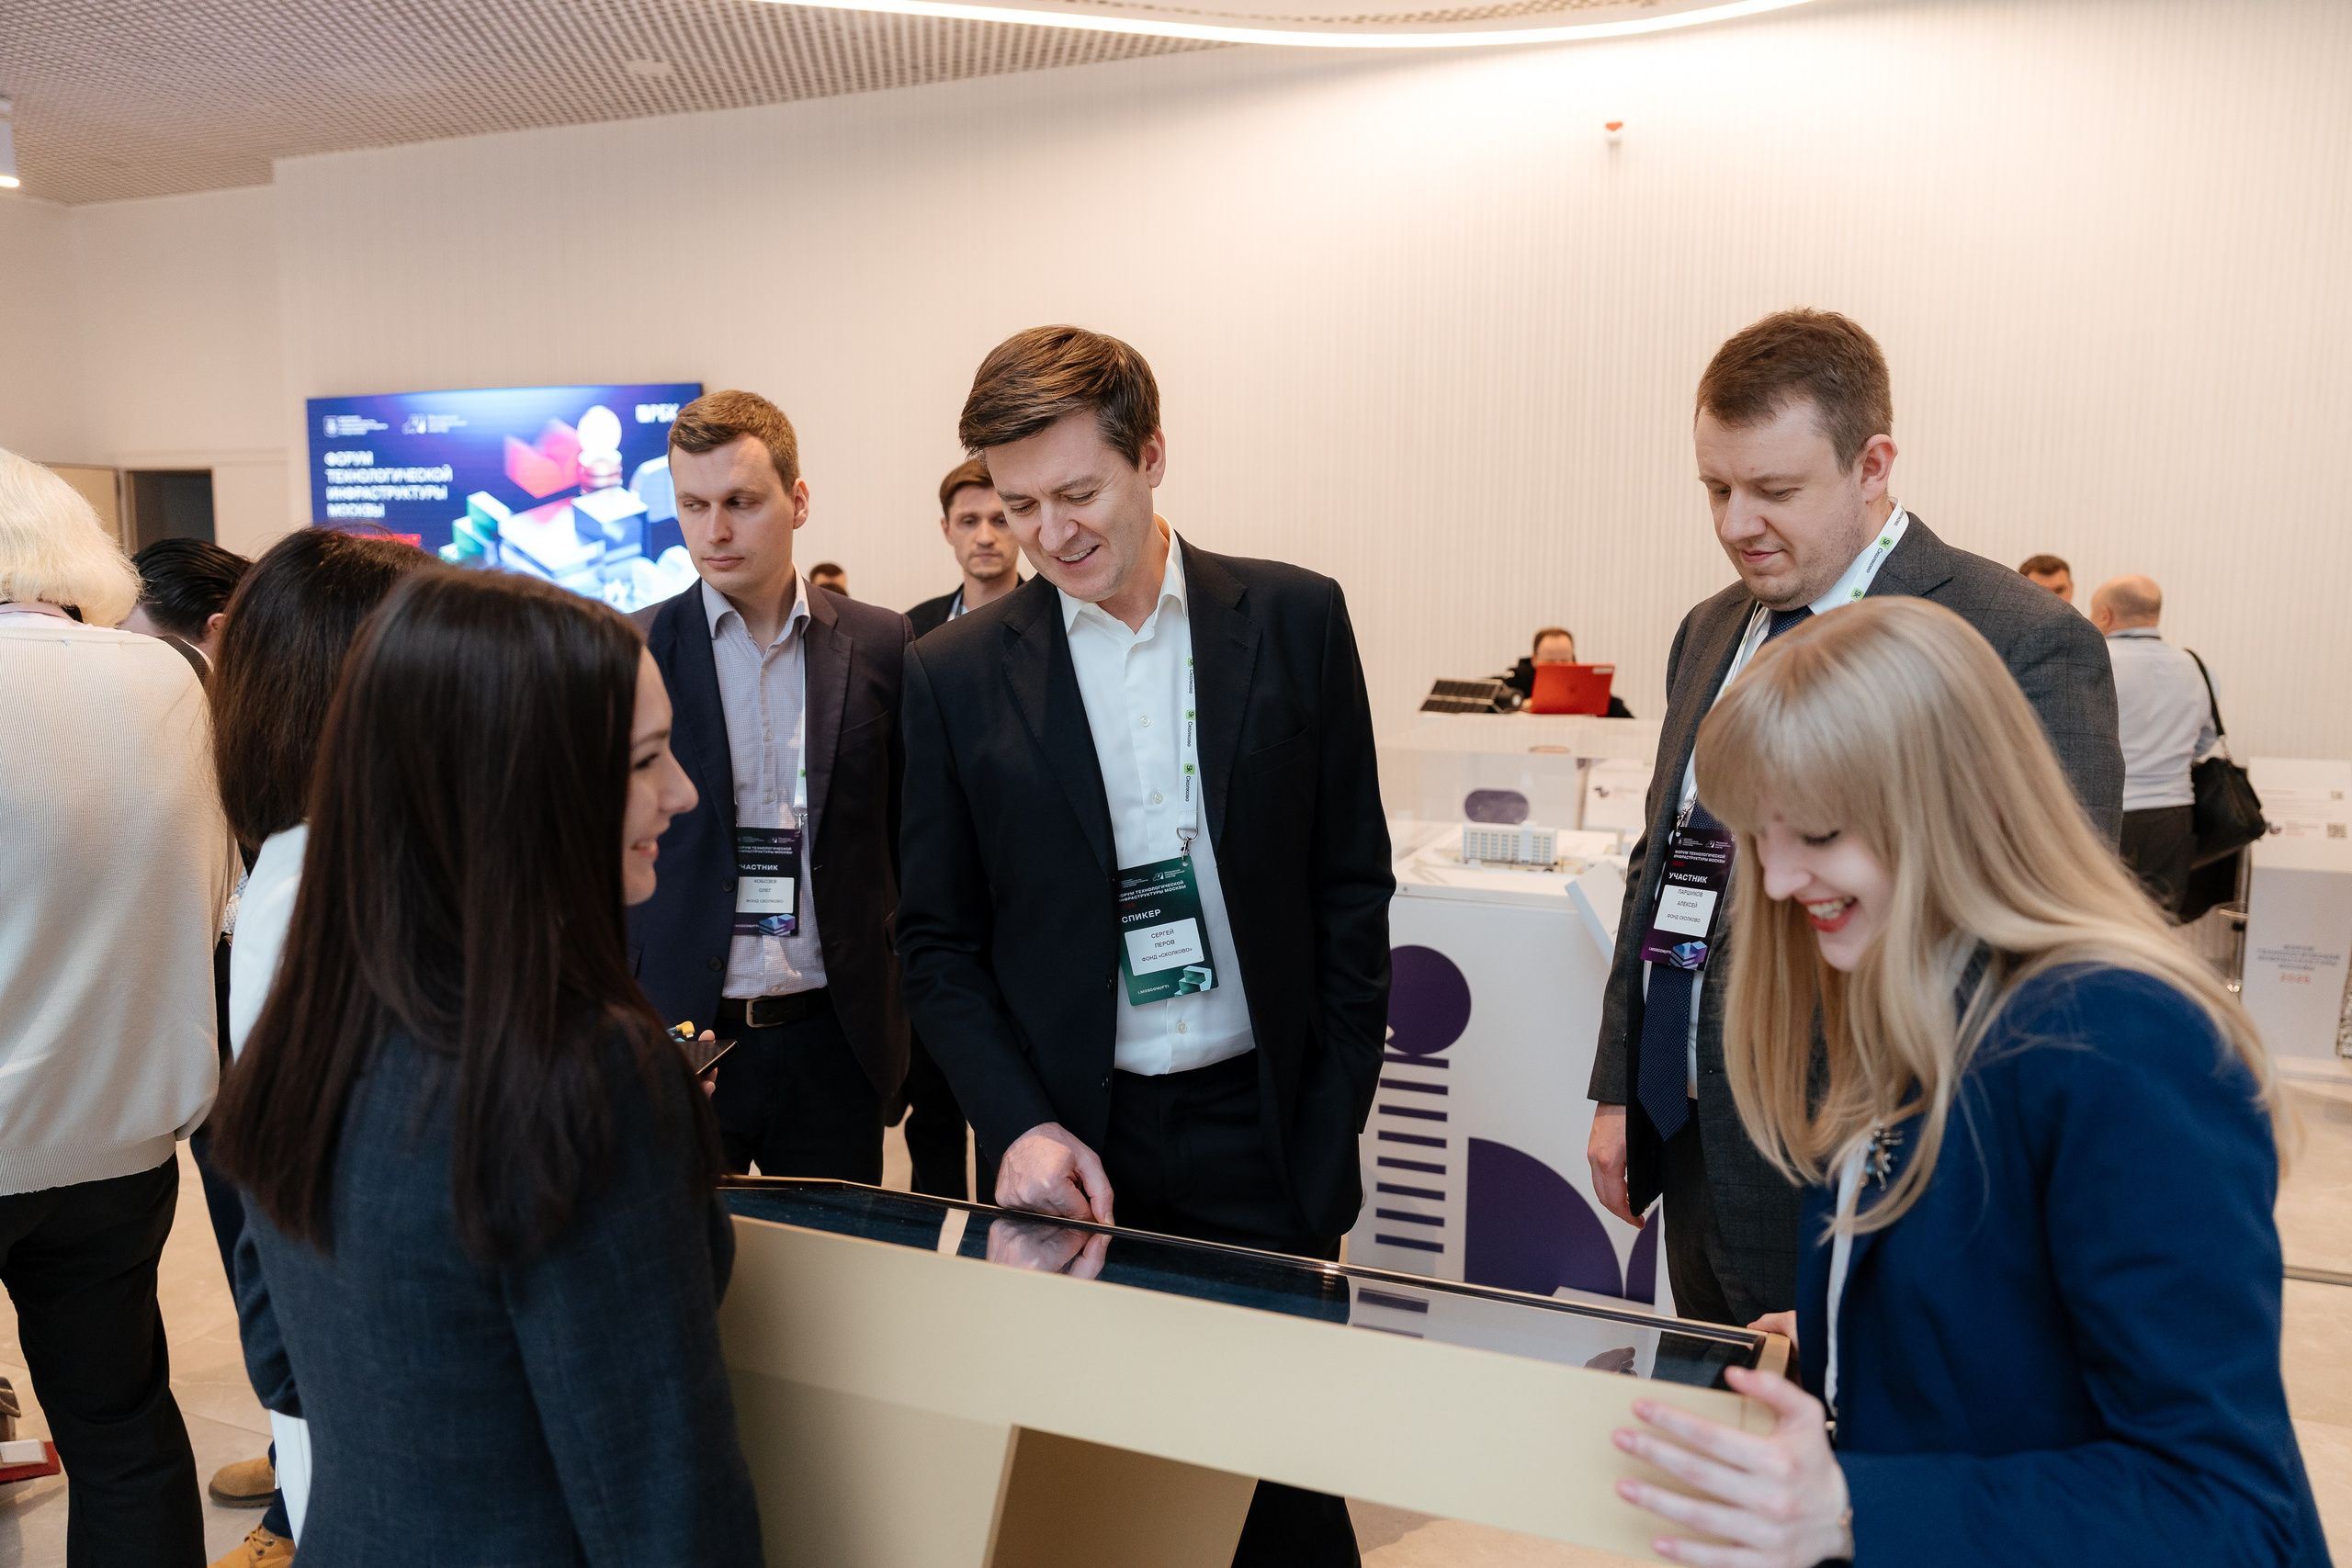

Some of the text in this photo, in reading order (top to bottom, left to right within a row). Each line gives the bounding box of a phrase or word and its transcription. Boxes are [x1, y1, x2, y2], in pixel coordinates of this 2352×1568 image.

[324, 450, 374, 467] ФОРУМ
[325, 464, 453, 484] ТЕХНОЛОГИЧЕСКОЙ
[326, 484, 448, 502] ИНФРАСТРУКТУРЫ
[327, 502, 385, 518] МОСКВЫ
[1866, 547, 1883, 573] Сколково
[1689, 851, 1726, 859] ТЕХНОЛОГИЧЕСКОЙ
[1668, 872, 1708, 884] УЧАСТНИК
[1136, 879, 1184, 895] ТЕХНОЛОГИЧЕСКОЙ
[1164, 885, 1187, 893] МОСКВЫ
[1678, 888, 1703, 897] ПАРШИКОВ
[1677, 900, 1698, 908] АЛЕКСЕЙ
[1121, 908, 1161, 923] СПИКЕР
[1679, 915, 1702, 923] СКОЛКОВО
[1150, 928, 1175, 939] СЕРГЕЙ
[1154, 939, 1176, 948] ПЕРОВ
[1141, 947, 1193, 962] ФОНД «СКОЛКОВО»
